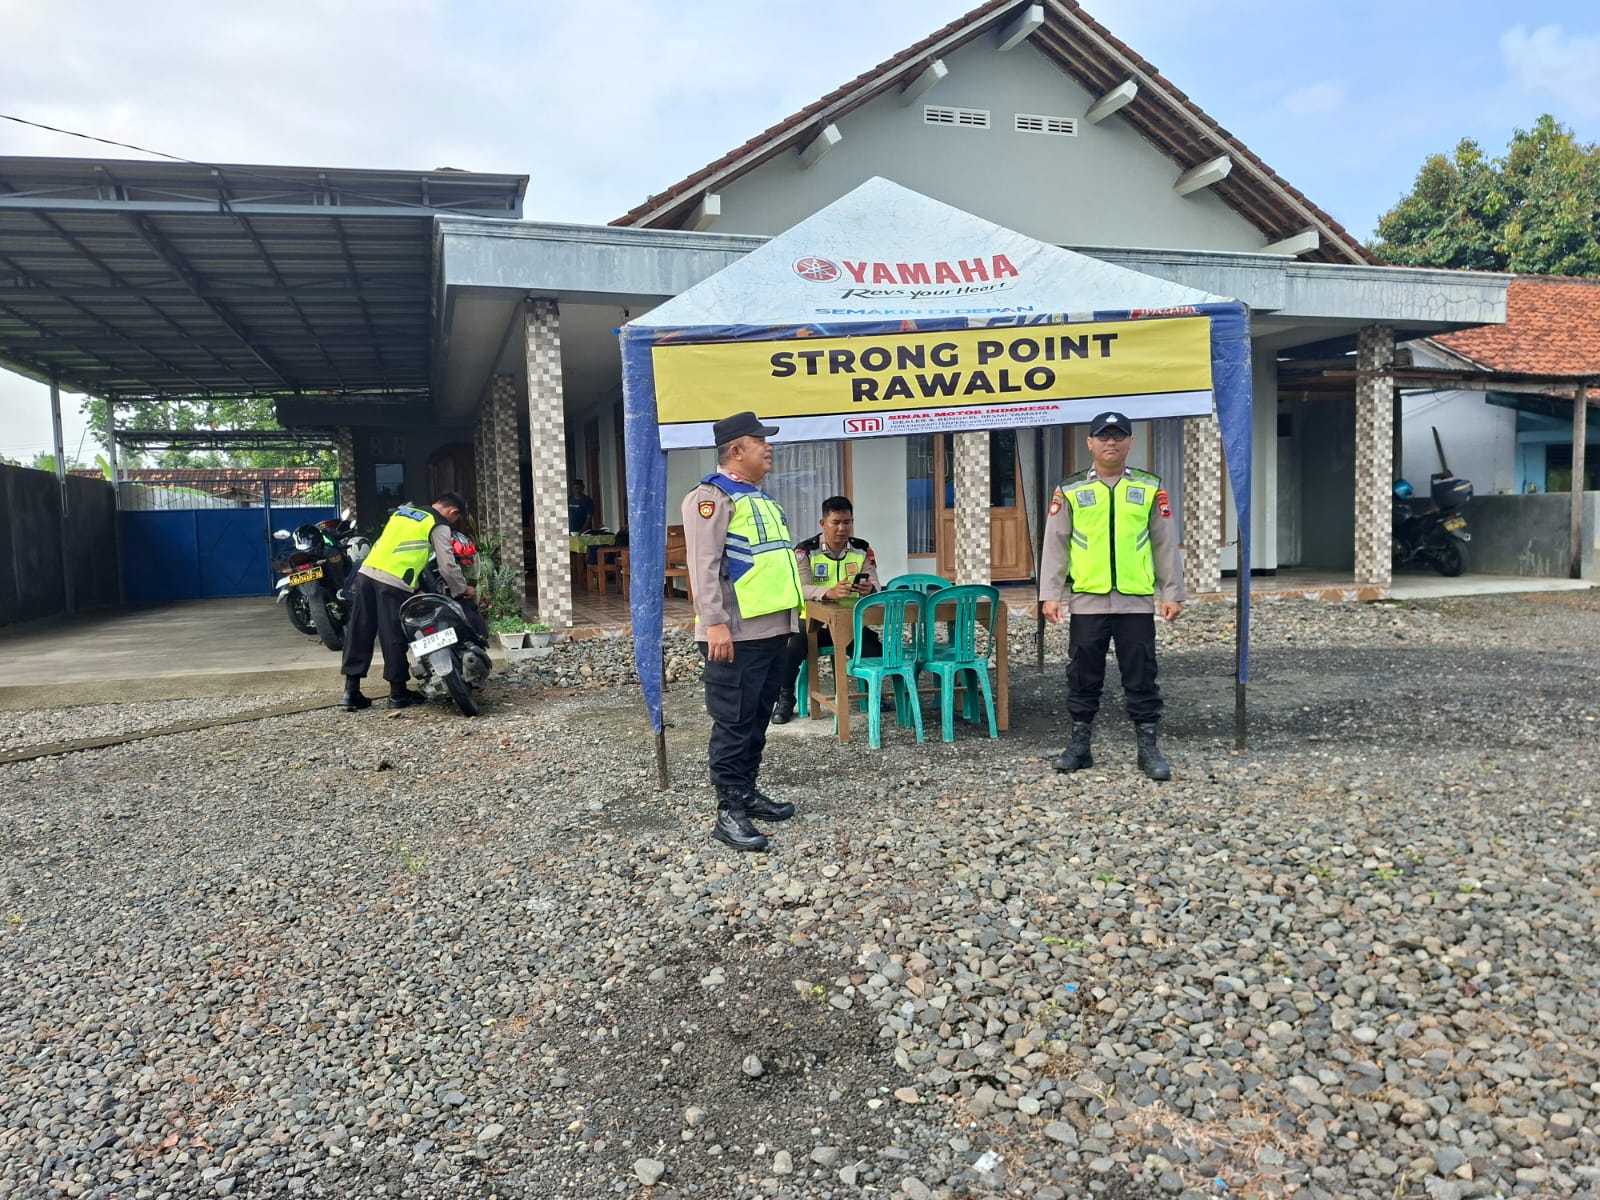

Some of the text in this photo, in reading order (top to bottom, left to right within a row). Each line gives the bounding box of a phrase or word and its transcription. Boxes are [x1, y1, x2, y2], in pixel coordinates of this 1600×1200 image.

[842, 253, 1019, 285] YAMAHA
[840, 282, 1006, 299] Revs your Heart
[815, 305, 1034, 316] SEMAKIN DI DEPAN
[770, 333, 1119, 377] STRONG POINT
[851, 366, 1056, 403] RAWALO
[934, 409, 982, 417] MOTOR
[986, 405, 1060, 414] INDONESIA
